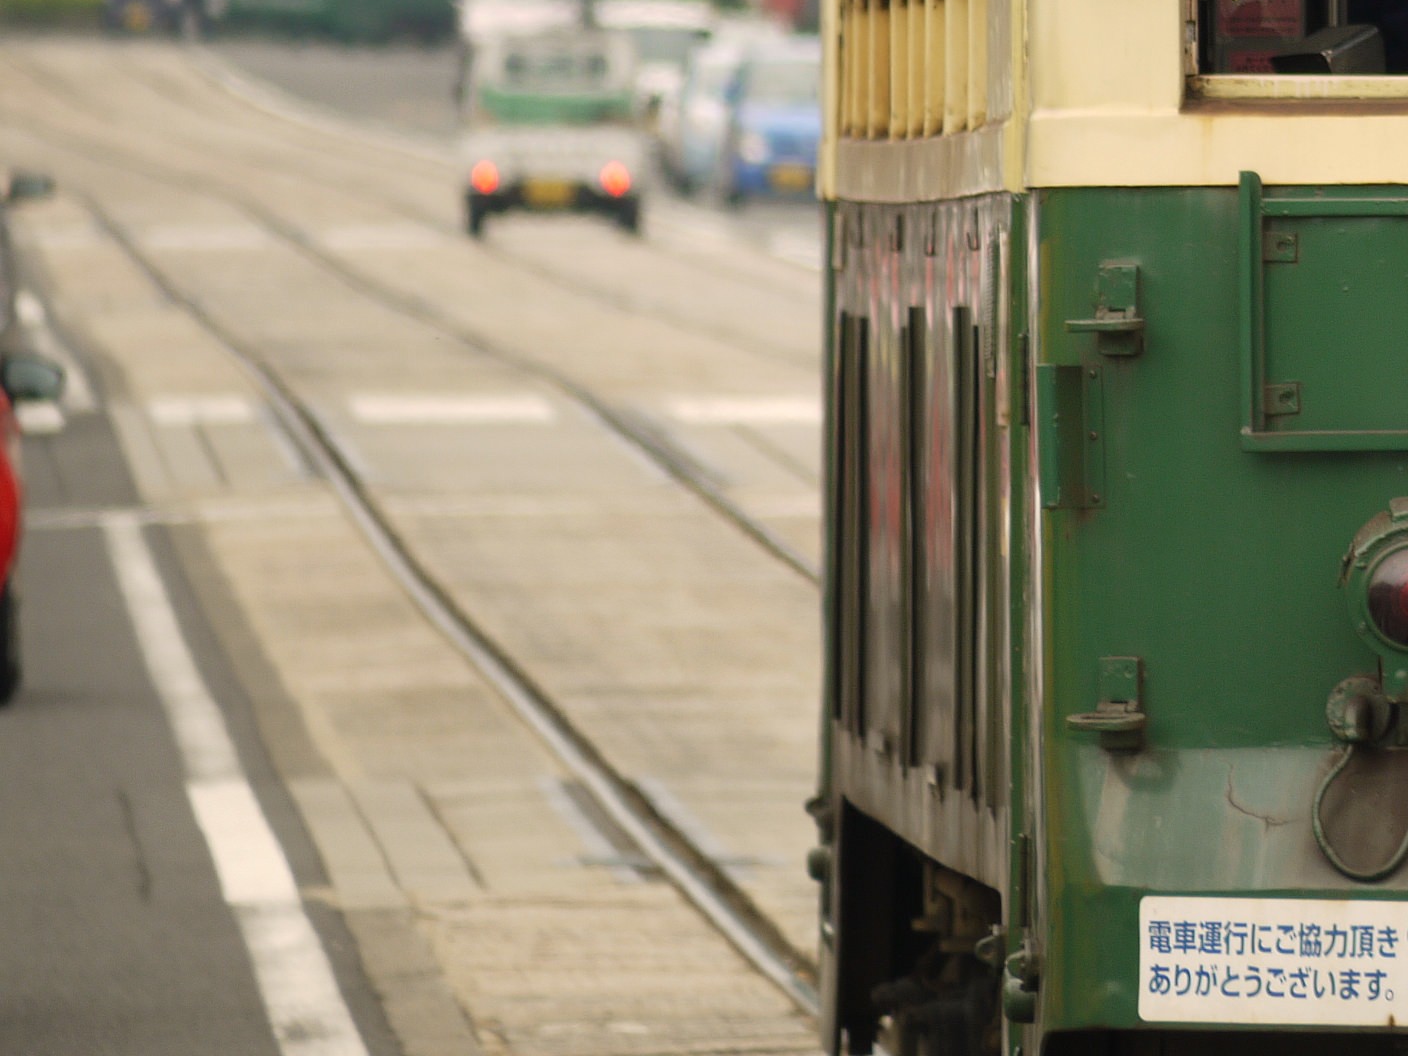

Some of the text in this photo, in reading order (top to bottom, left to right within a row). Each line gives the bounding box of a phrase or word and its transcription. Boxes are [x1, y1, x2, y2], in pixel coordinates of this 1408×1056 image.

[1148, 920, 1399, 958] 電車運行にご協力頂き
[1148, 964, 1395, 1002] ありがとうございます。
